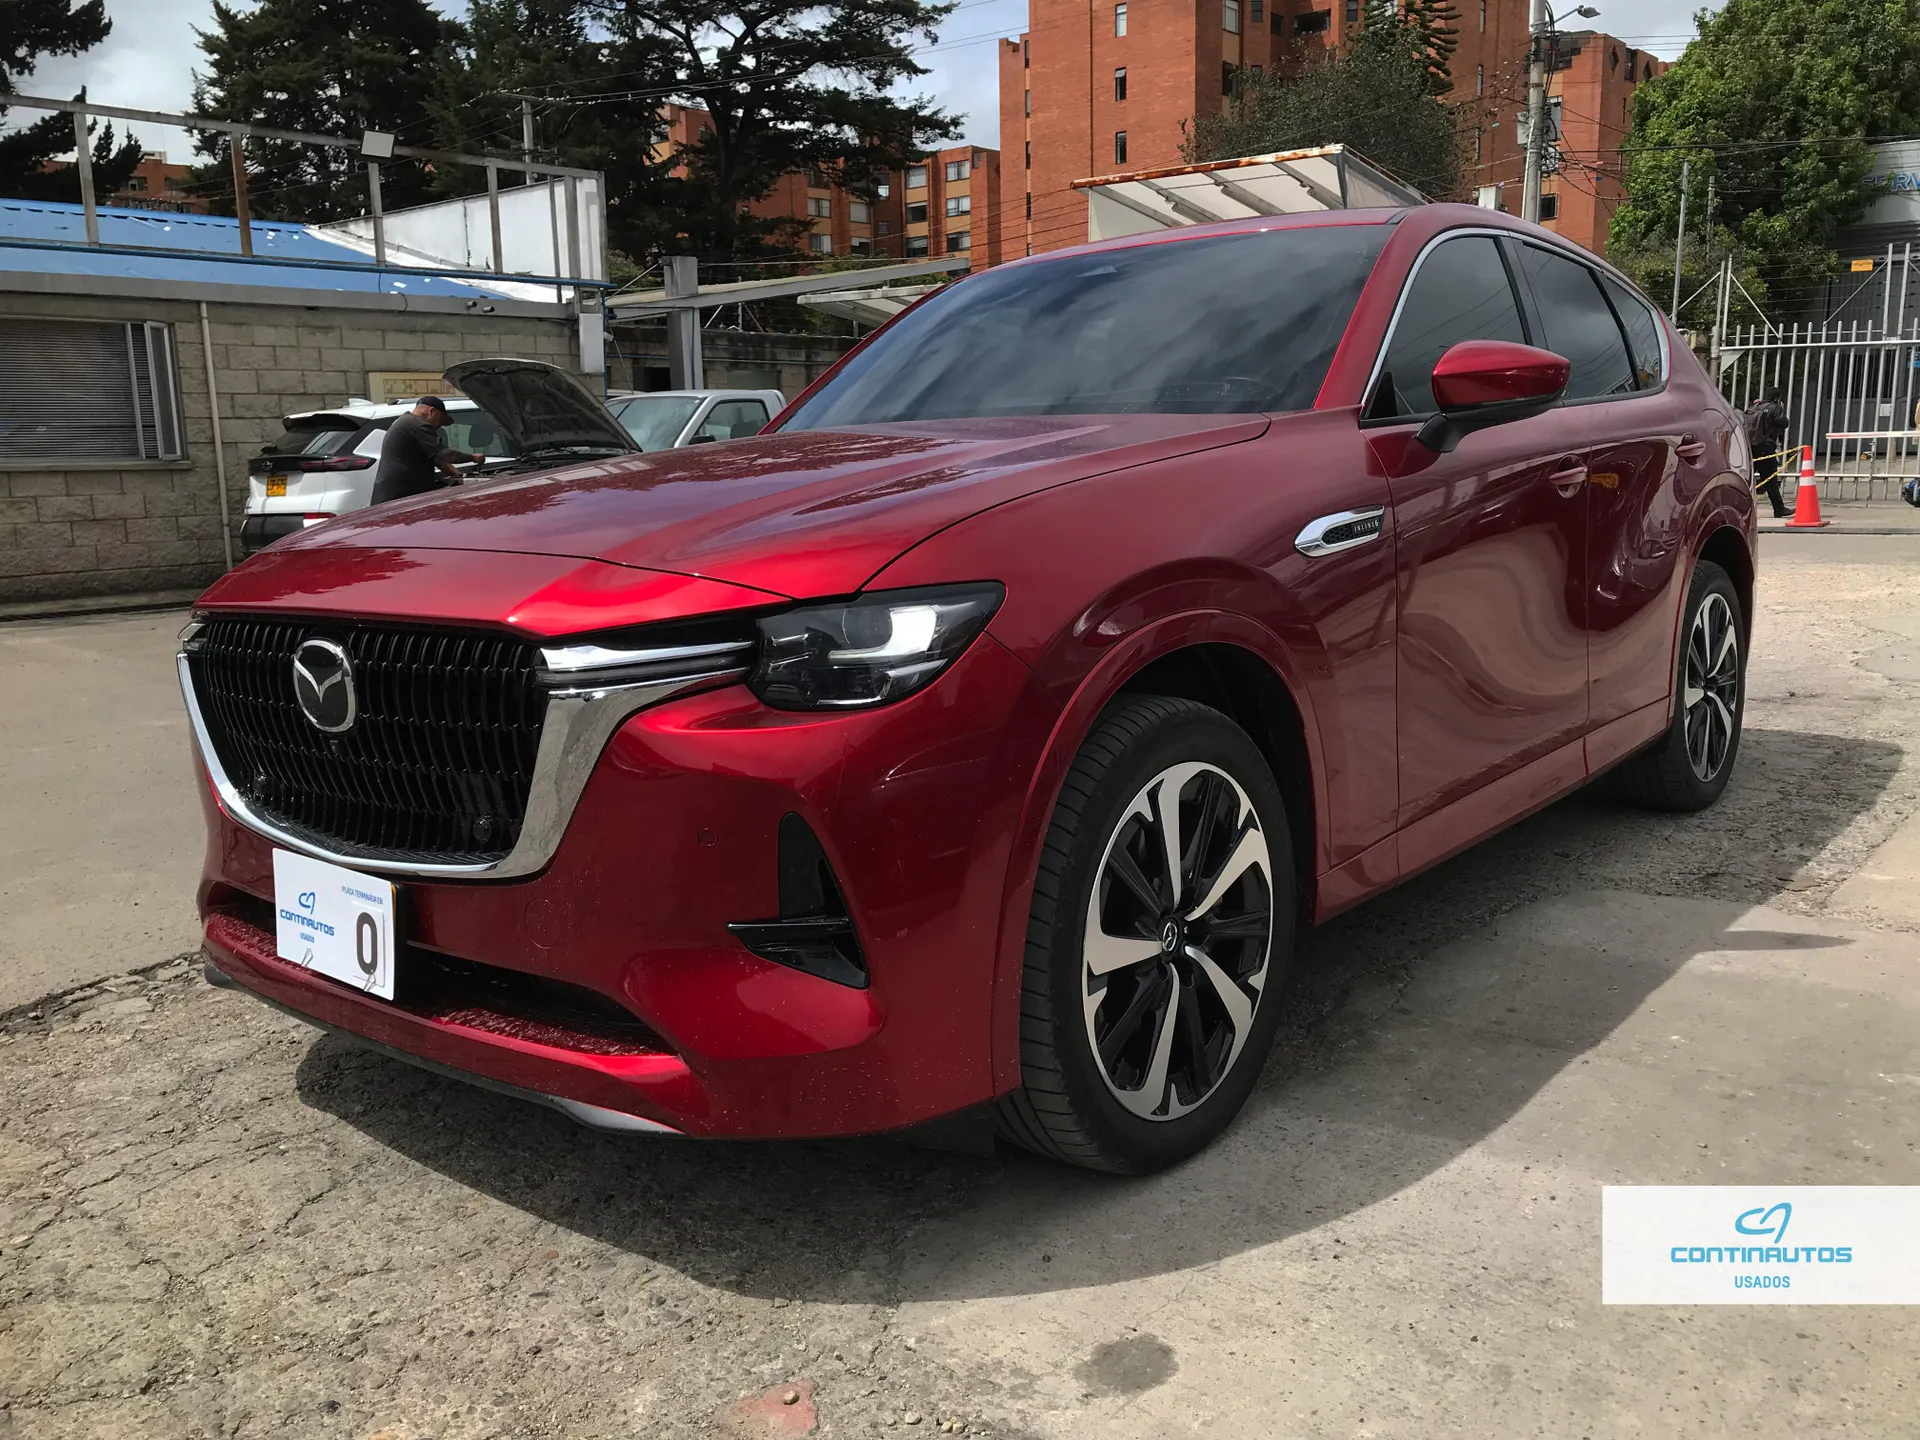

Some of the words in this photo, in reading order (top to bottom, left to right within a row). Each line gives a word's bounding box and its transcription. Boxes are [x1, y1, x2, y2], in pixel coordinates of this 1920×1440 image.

[341, 885, 354, 896] PLACA
[354, 889, 377, 903] TERMINADA
[376, 896, 384, 905] EN
[280, 909, 335, 936] CONTINAUTOS
[300, 932, 315, 943] USADOS
[356, 911, 378, 975] 0
